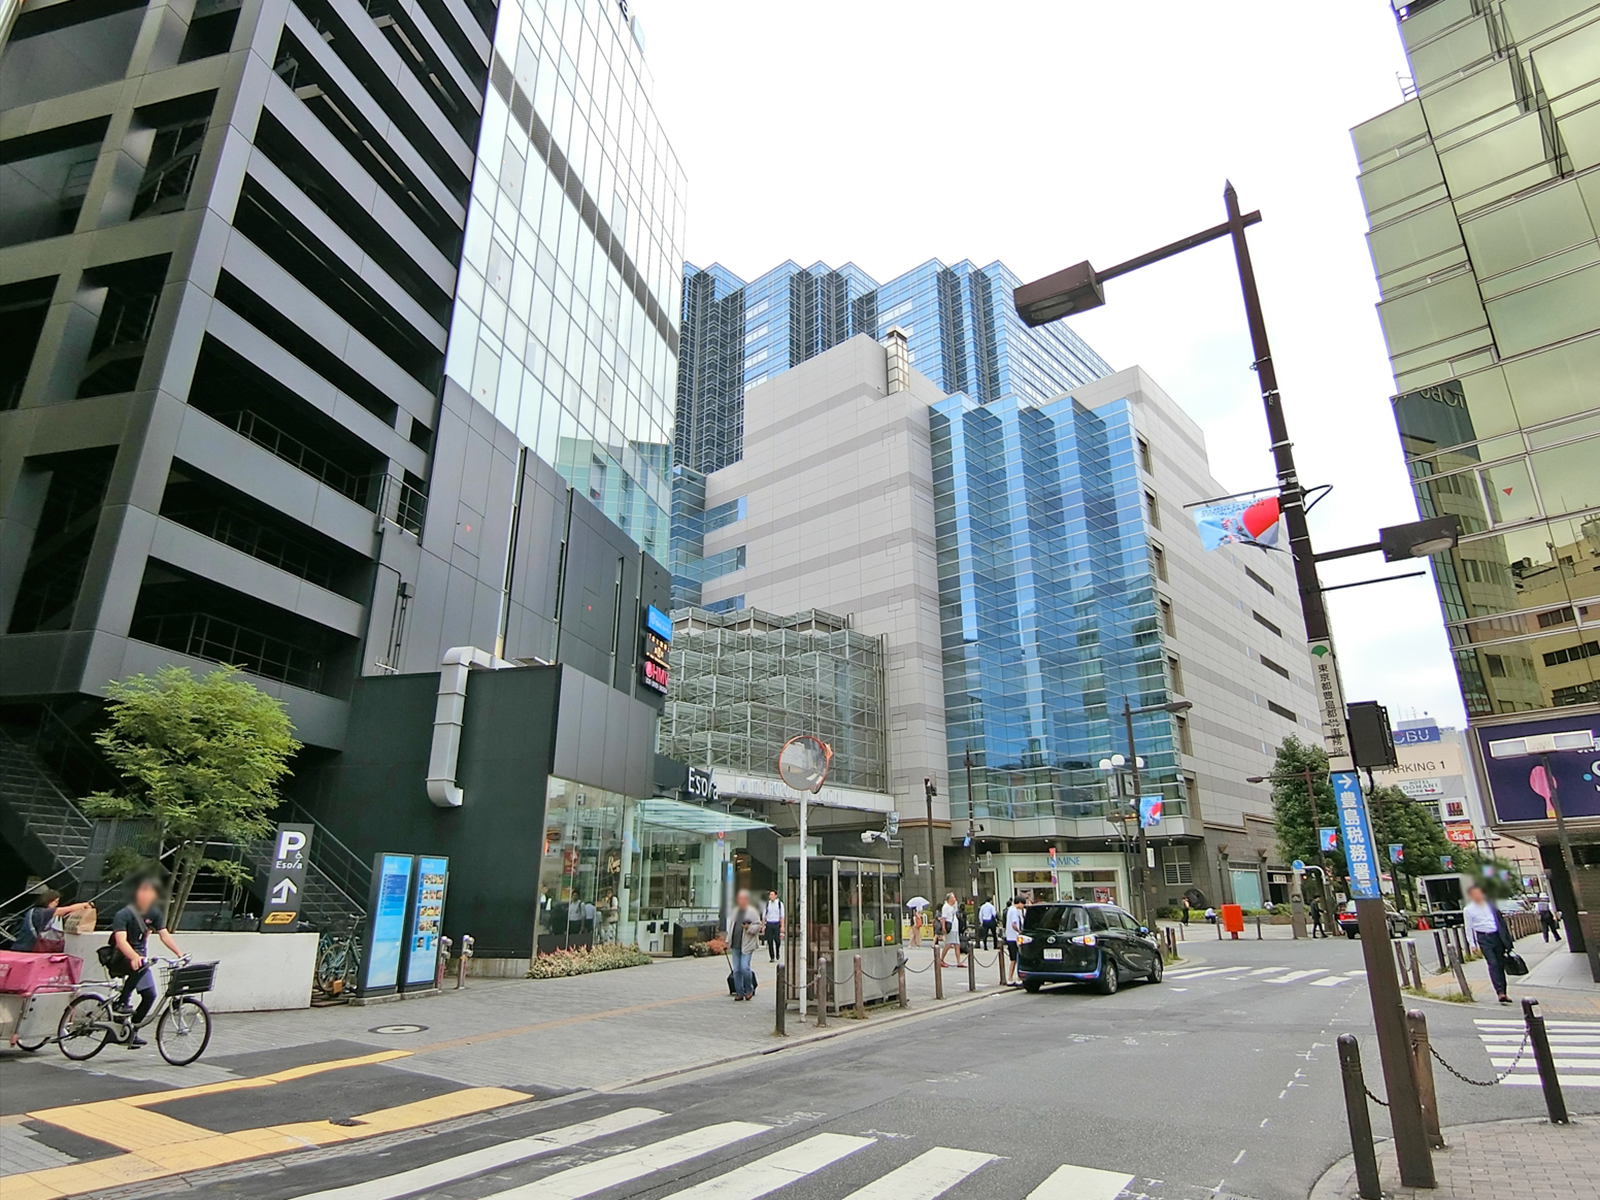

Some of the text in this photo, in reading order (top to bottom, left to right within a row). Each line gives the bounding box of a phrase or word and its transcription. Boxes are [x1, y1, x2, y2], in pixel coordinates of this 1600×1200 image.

[652, 663, 670, 687] HMV
[1394, 729, 1430, 744] OBU
[1439, 760, 1446, 769] 1
[1402, 783, 1438, 791] DOMANI
[278, 831, 307, 860] P
[1340, 791, 1371, 888] 豊島税務署
[276, 859, 303, 870] Esora
[1046, 856, 1081, 866] LMINE
